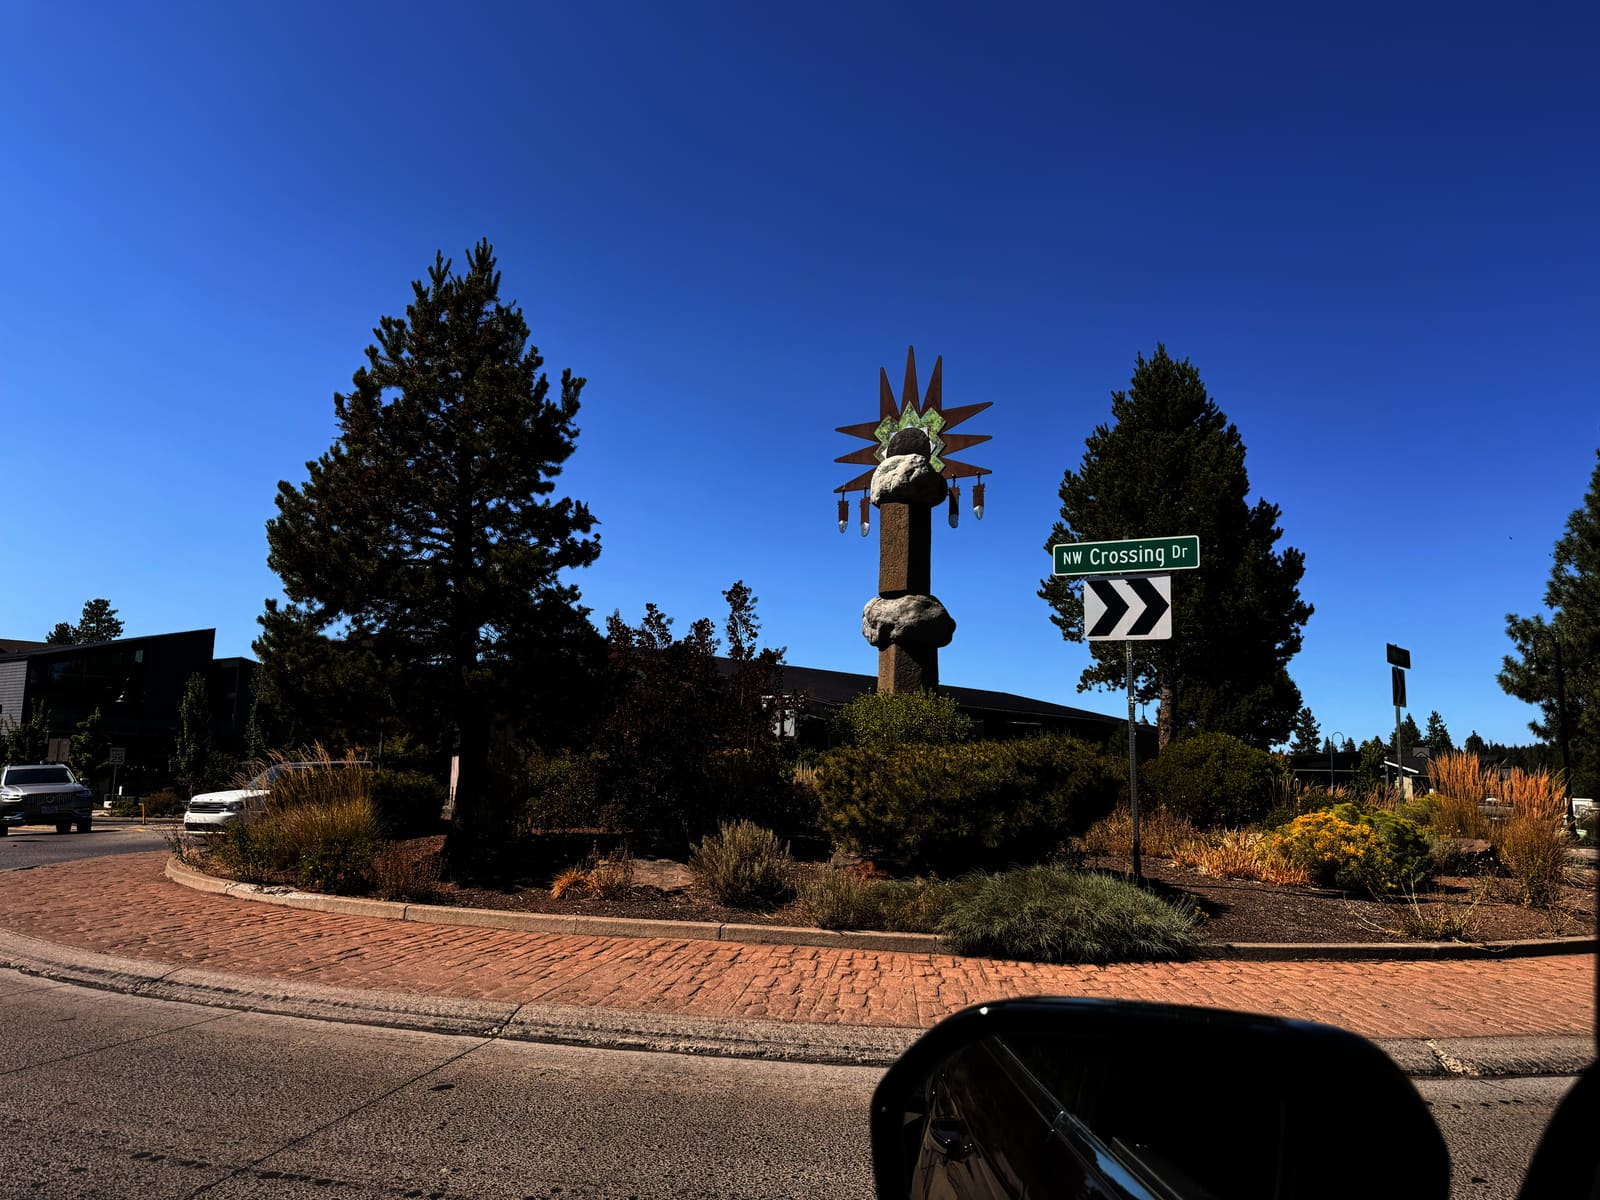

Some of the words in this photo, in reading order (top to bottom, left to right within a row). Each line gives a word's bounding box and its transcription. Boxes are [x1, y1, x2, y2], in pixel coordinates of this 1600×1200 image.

[1063, 551, 1083, 565] NW
[1089, 545, 1165, 567] Crossing
[1172, 545, 1188, 559] Dr
